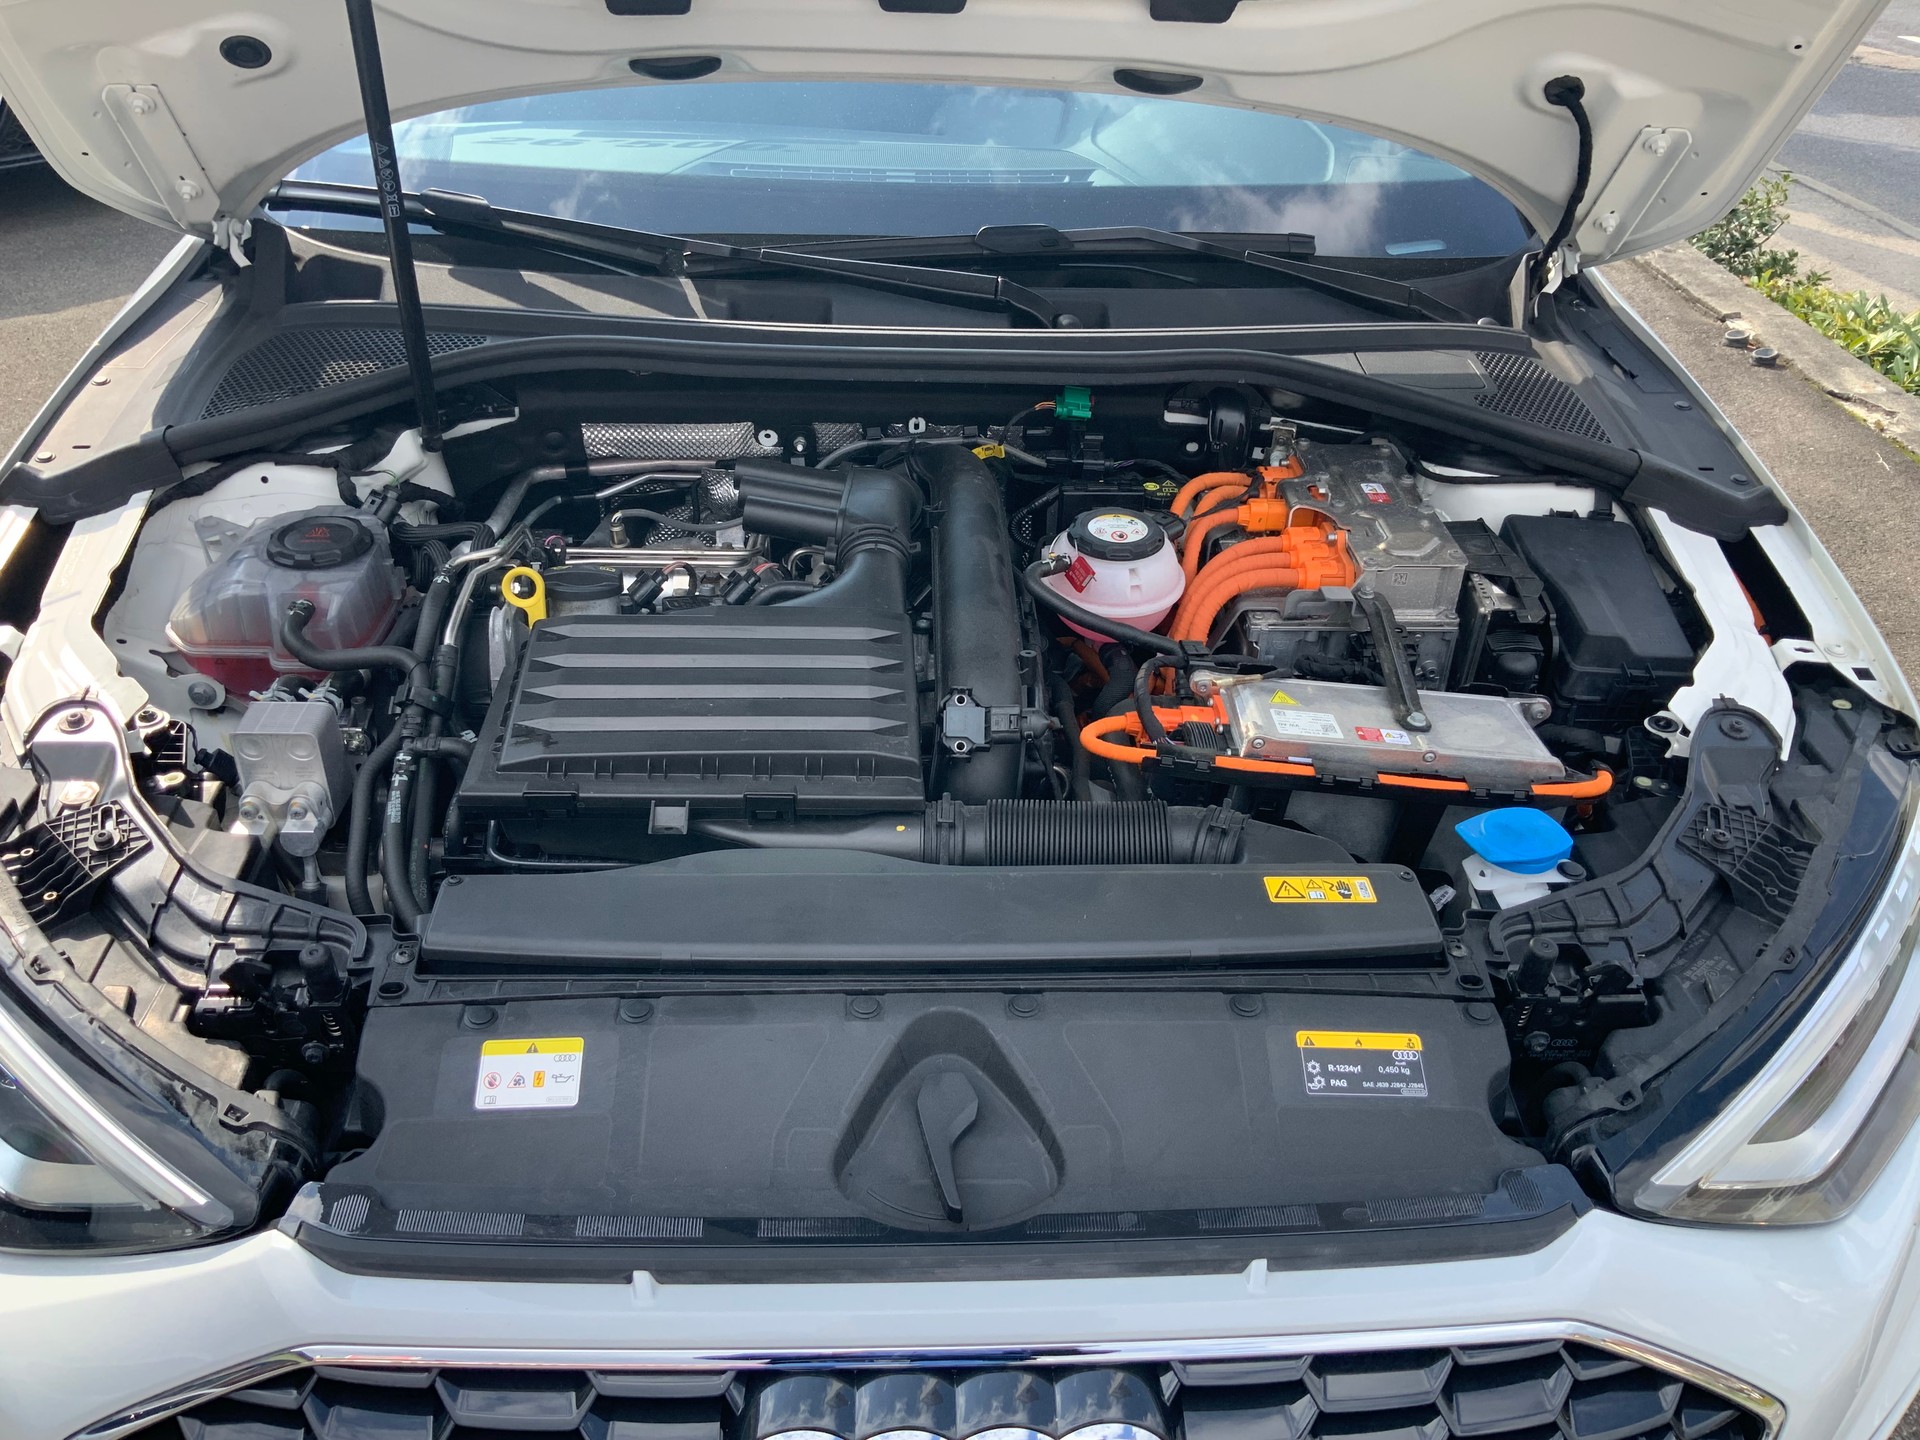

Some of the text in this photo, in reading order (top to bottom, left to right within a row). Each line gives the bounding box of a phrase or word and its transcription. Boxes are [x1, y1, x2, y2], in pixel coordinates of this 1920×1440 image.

[1328, 1064, 1361, 1073] R-1234yf
[1378, 1066, 1410, 1075] 0,450 kg
[1330, 1079, 1347, 1087] PAG
